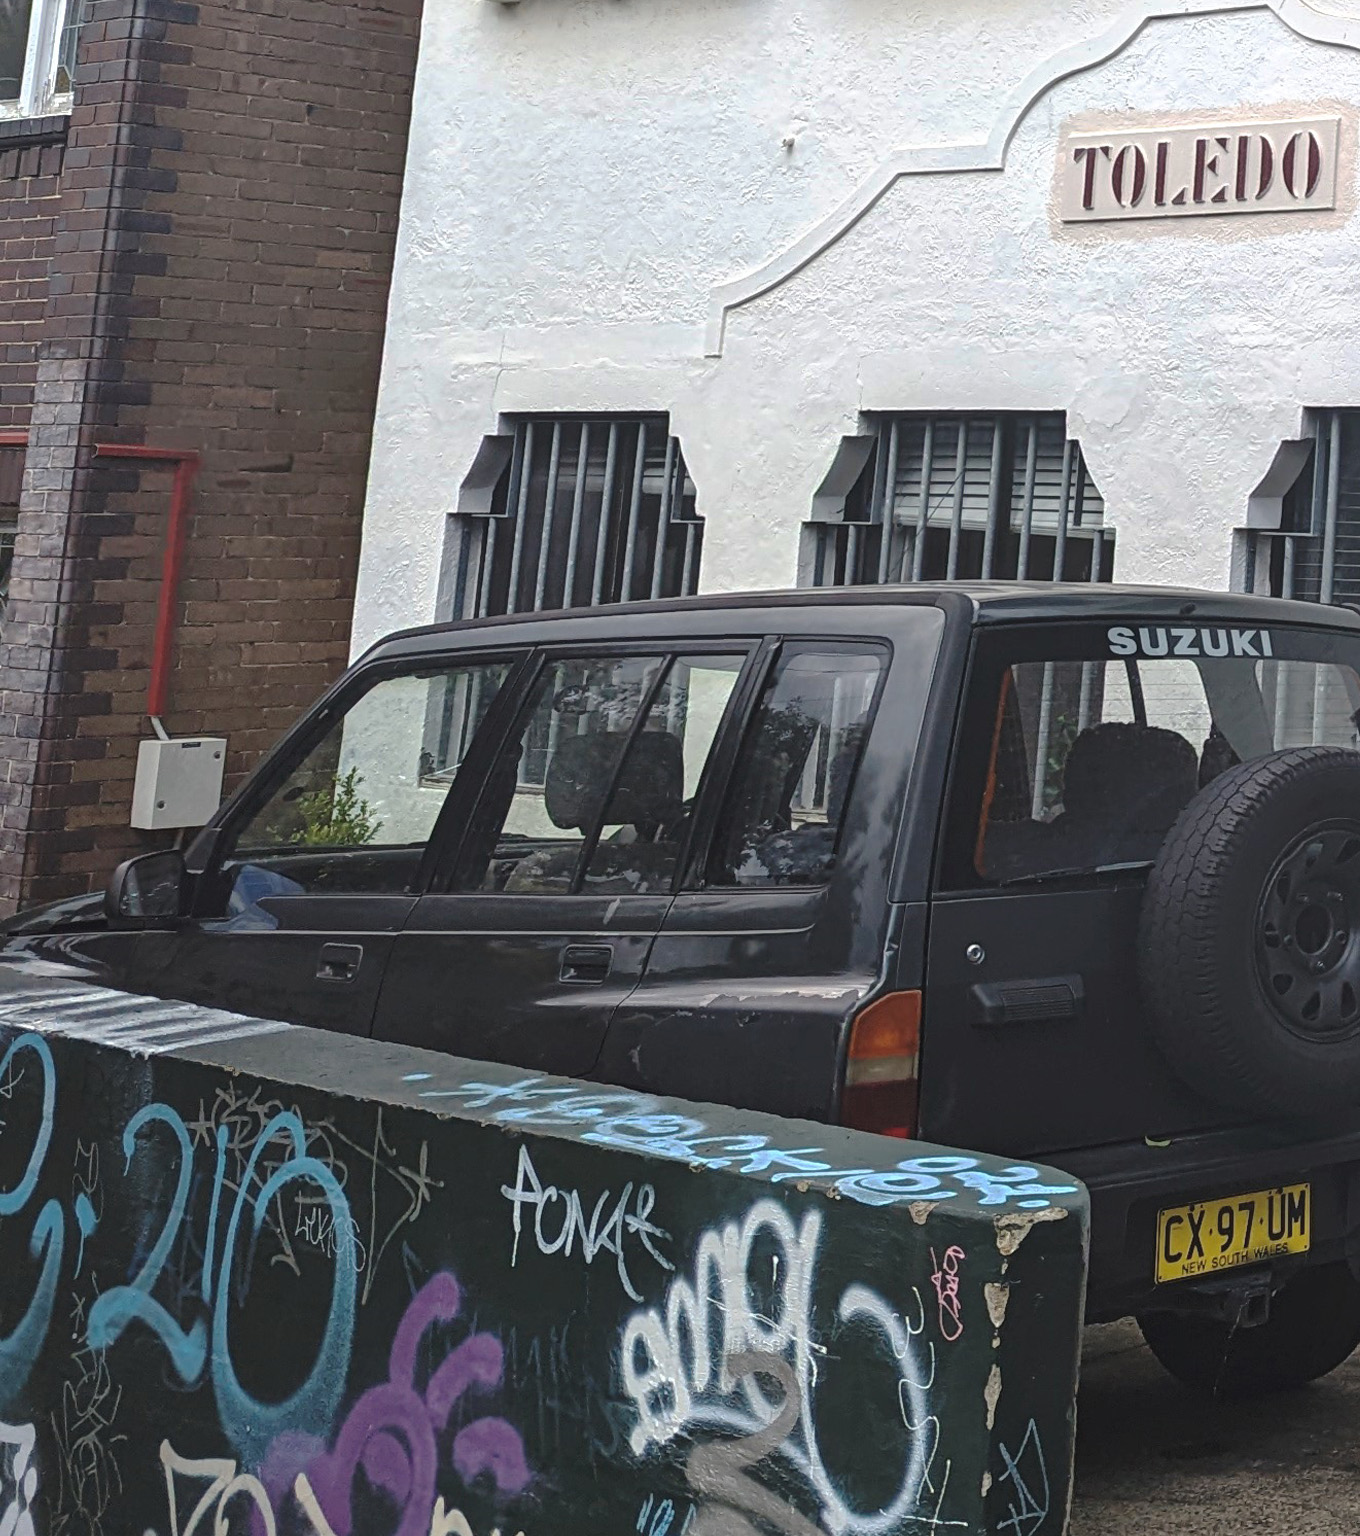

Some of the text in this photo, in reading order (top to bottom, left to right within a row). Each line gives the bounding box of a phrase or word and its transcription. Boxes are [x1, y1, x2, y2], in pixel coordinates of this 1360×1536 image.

[1073, 131, 1321, 210] TOLEDO
[1107, 626, 1273, 657] SUZUKI
[1181, 1242, 1288, 1275] NEW SOUTH WALES
